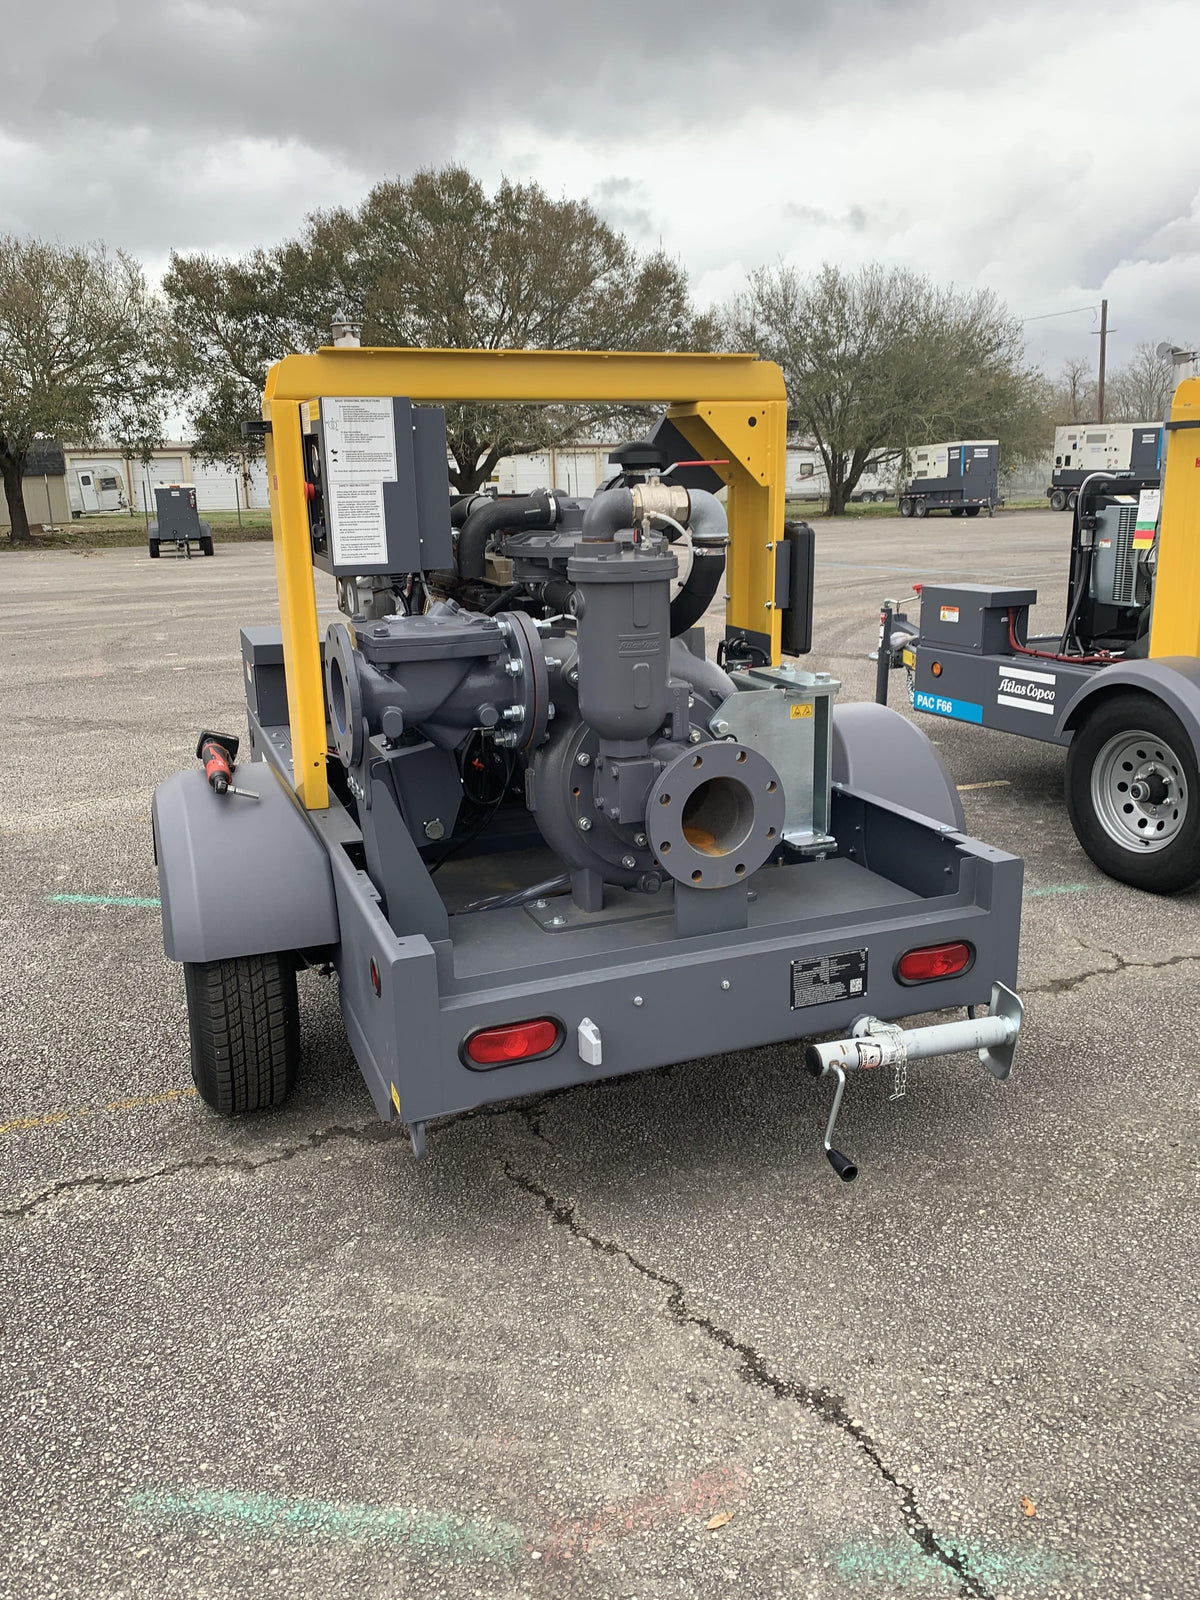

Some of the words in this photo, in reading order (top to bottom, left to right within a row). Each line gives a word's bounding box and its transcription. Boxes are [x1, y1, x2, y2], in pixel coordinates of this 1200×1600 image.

[998, 679, 1027, 696] Atlas
[1026, 683, 1056, 701] Copco
[917, 694, 935, 709] PAC
[936, 698, 953, 713] F66
